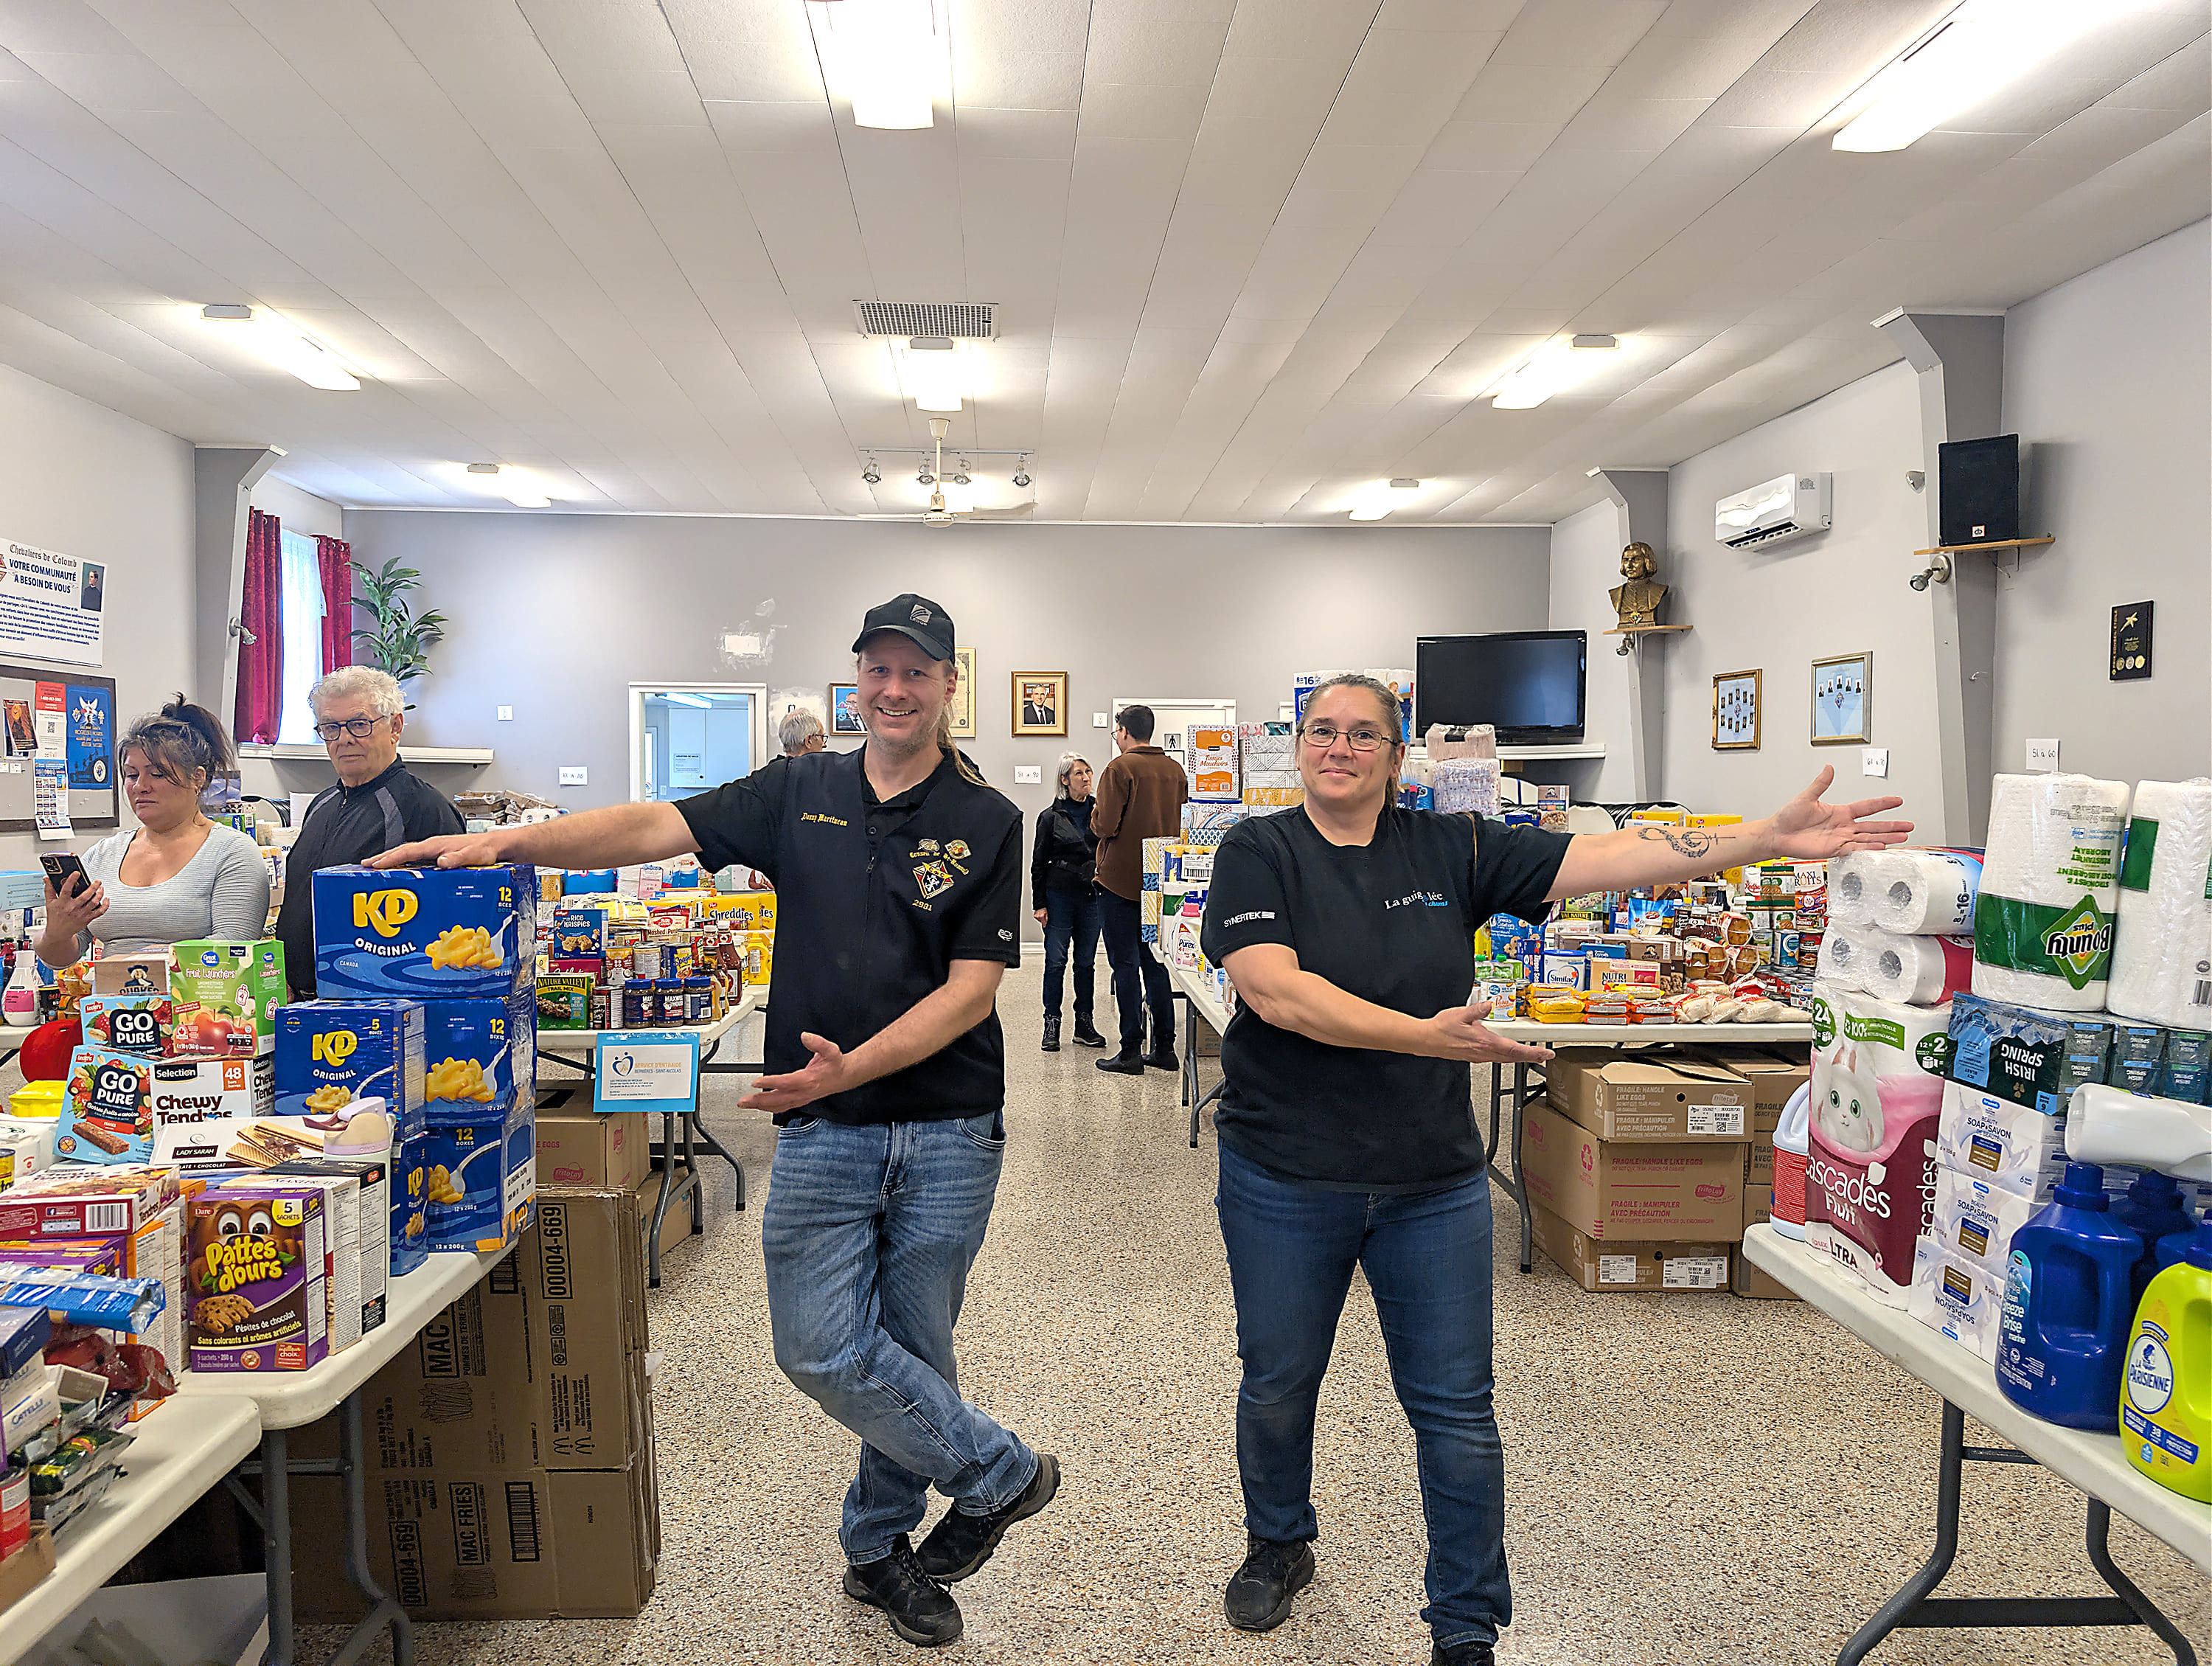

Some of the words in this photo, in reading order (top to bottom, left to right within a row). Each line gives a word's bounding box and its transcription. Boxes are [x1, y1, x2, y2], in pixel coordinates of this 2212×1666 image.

[10, 544, 42, 560] Chevaliers
[43, 552, 51, 561] de
[52, 555, 77, 568] Colomb
[9, 558, 30, 572] VOTRE
[30, 563, 77, 582] COMMUNAUTÉ
[20, 575, 43, 589] BESOIN
[44, 580, 53, 590] DE
[54, 582, 71, 594] VOUS
[498, 886, 512, 902] 12
[353, 889, 419, 937] KD
[912, 899, 932, 912] 2981
[1385, 899, 1400, 910] La
[709, 908, 754, 920] Shreddies
[1224, 911, 1262, 928] SYNERTEK
[2073, 921, 2095, 931] plus
[355, 937, 417, 957] ORIGINAL
[1179, 939, 1195, 949] Purex
[2047, 924, 2112, 958] Bounty
[339, 960, 358, 968] CANADA
[186, 968, 201, 979] Fruit
[203, 968, 236, 979] Launchers
[1550, 972, 1573, 983] Similac
[1601, 972, 1627, 980] NUTRI
[538, 978, 562, 989] NATURE
[561, 978, 585, 988] VALLEY
[239, 993, 245, 1002] 4
[1815, 1003, 1831, 1024] 24
[116, 1013, 153, 1032] GO
[372, 1019, 380, 1030] 5
[490, 1018, 504, 1034] 12
[116, 1031, 155, 1044] PURE
[312, 1030, 358, 1066] KD
[2000, 1044, 2045, 1067] SPRING
[156, 1069, 196, 1079] Selection
[225, 1067, 242, 1080] 48
[313, 1069, 356, 1081] ORIGINAL
[2005, 1061, 2036, 1082] IRISH
[100, 1071, 137, 1093] GO
[97, 1088, 134, 1106] PURE
[156, 1094, 223, 1111] Chewy
[1966, 1117, 1986, 1128] SOAP
[1988, 1125, 2011, 1139] SAVON
[1982, 1116, 1997, 1125] BEAUTY
[456, 1128, 474, 1141] 12
[408, 1167, 423, 1196] KD
[195, 1207, 212, 1215] Dare
[285, 1202, 293, 1212] 5
[1958, 1199, 1975, 1212] SOAP
[1976, 1209, 1998, 1224] SAVON
[1971, 1199, 1986, 1209] BEAUTY
[206, 1235, 276, 1277] Pattes
[543, 1206, 567, 1297] 00004-669
[218, 1259, 283, 1292] d'ours
[1935, 1296, 1955, 1312] SAVON
[235, 1324, 260, 1333] Pépites
[261, 1322, 270, 1330] de
[270, 1311, 296, 1327] chocolat
[459, 1311, 467, 1333] TERRE
[1958, 1311, 1975, 1325] SOAP
[2003, 1315, 2023, 1333] Brise
[198, 1336, 213, 1344] Sans
[213, 1336, 243, 1344] colorants
[250, 1331, 272, 1342] arômes
[273, 1321, 302, 1336] artificiels
[460, 1336, 468, 1344] DE
[2008, 1333, 2026, 1344] marine
[425, 1325, 453, 1373] MAC
[461, 1345, 470, 1375] POMMES
[2129, 1364, 2171, 1393] PARISIENNE
[12, 1398, 44, 1426] CATELLI
[2152, 1426, 2162, 1437] 38
[456, 1487, 475, 1527] FRIES
[460, 1531, 479, 1561] MAC
[395, 1524, 422, 1604] 00004-669
